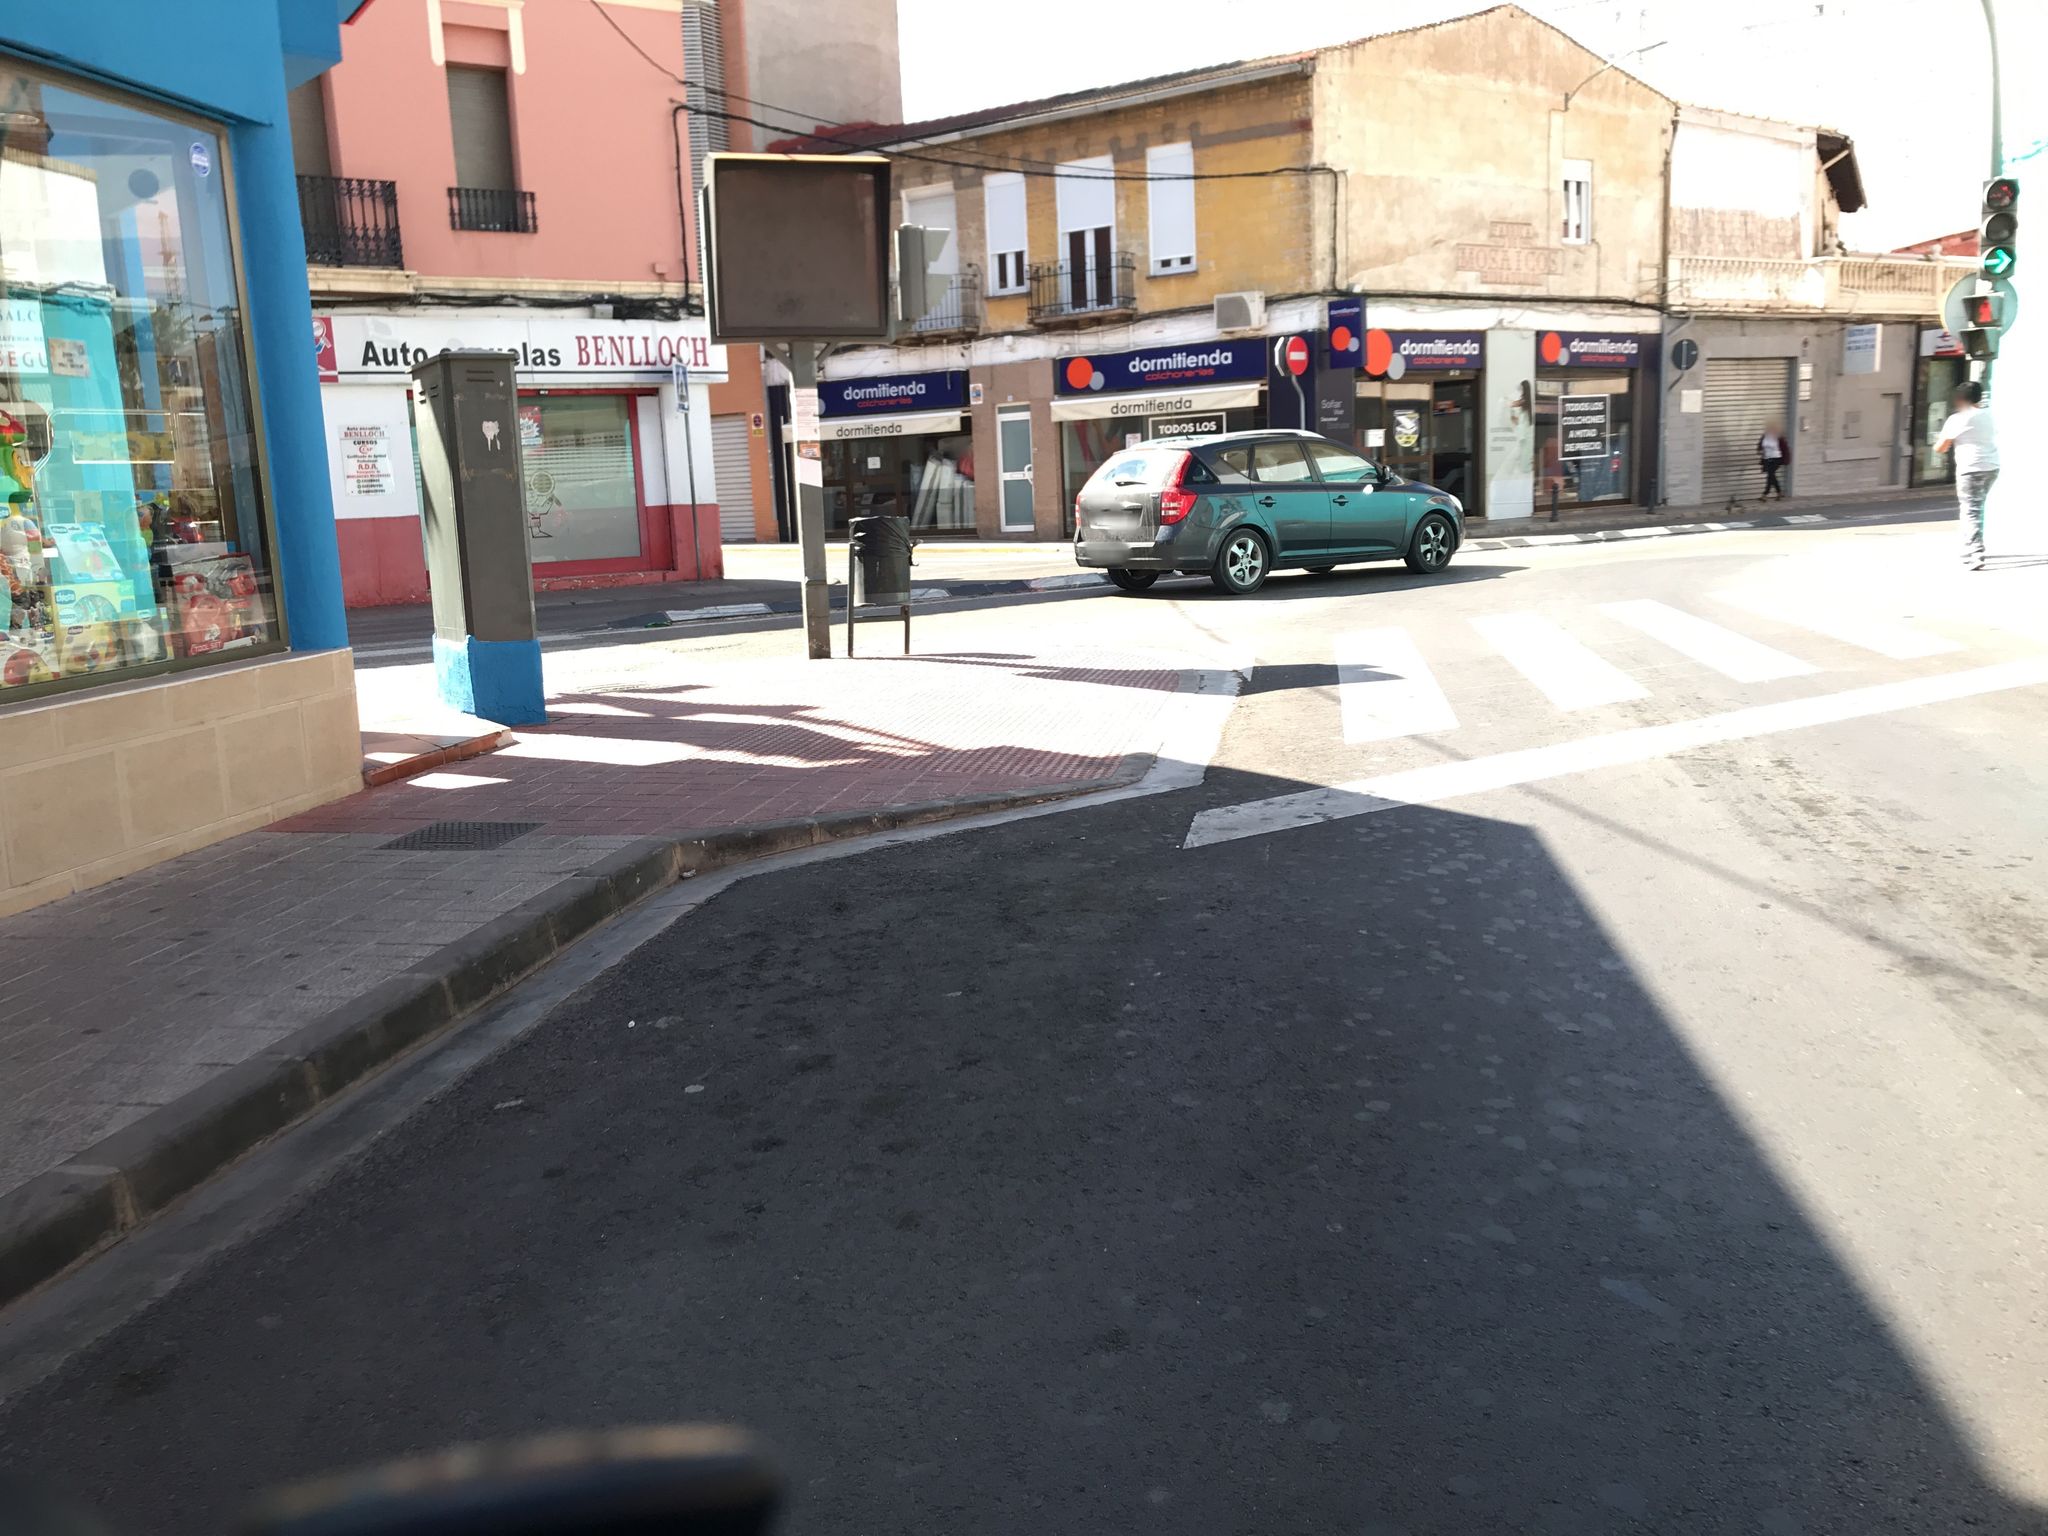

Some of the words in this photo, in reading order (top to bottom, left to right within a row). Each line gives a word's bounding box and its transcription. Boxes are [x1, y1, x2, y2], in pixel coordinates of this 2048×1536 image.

[575, 335, 709, 367] BENLLOCH
[1400, 339, 1480, 356] dormitienda
[1569, 338, 1639, 354] dormitienda
[1128, 350, 1233, 373] dormitienda
[843, 381, 926, 401] dormitienda
[1110, 397, 1192, 415] dormitienda
[836, 423, 902, 438] dormitienda
[1158, 423, 1194, 434] TODOS
[1196, 421, 1217, 432] LOS
